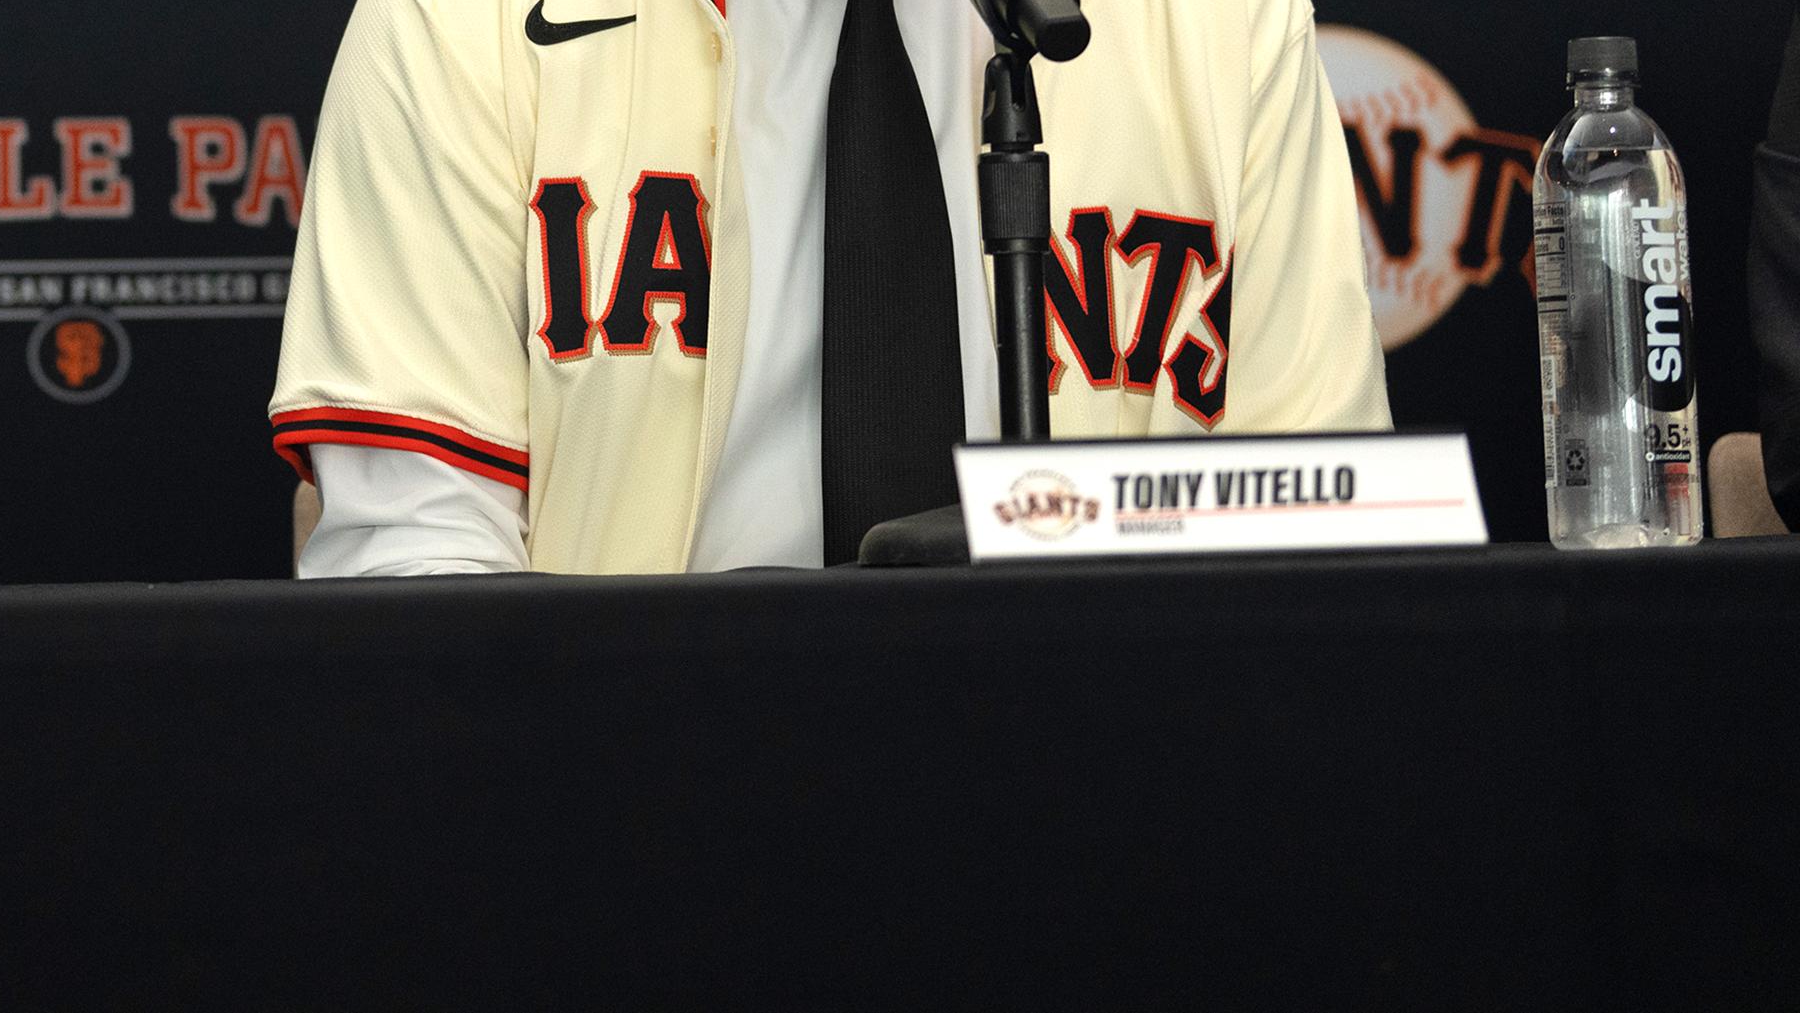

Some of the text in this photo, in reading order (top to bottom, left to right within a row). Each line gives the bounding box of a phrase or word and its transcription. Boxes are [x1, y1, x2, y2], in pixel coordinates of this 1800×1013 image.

[169, 112, 307, 229] PA
[1631, 198, 1685, 384] smart
[1111, 465, 1356, 510] TONY VITELLO
